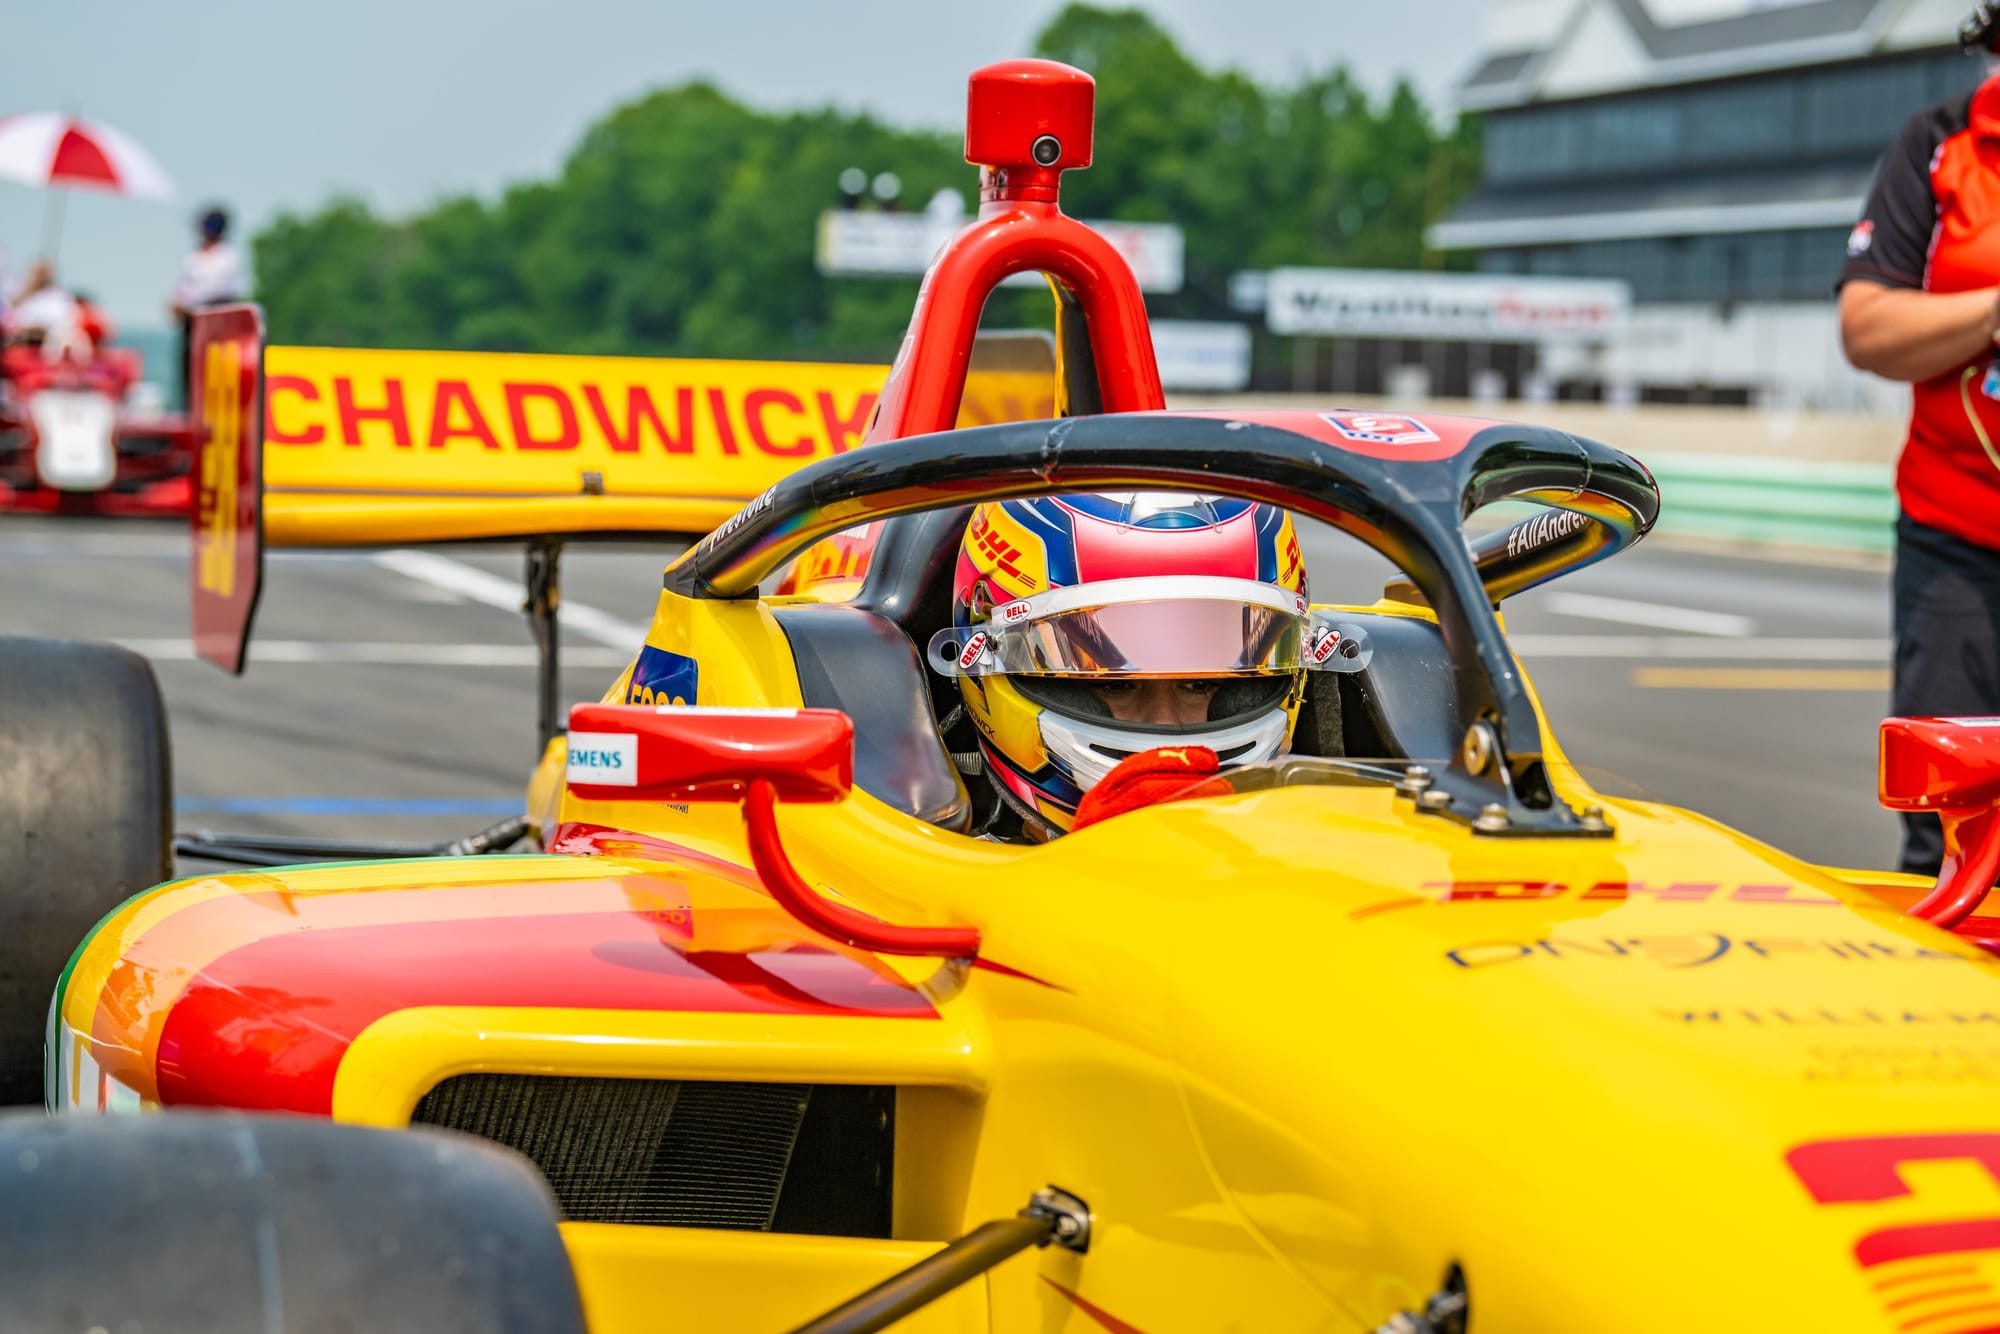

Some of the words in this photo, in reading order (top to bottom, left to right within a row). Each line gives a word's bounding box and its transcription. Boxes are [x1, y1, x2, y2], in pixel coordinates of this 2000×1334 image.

[265, 375, 879, 457] CHADWICK
[971, 508, 1022, 579] DHL
[1006, 604, 1028, 618] BELL
[960, 636, 986, 666] BELL
[1314, 633, 1341, 662] BELL
[568, 749, 623, 769] EMENS
